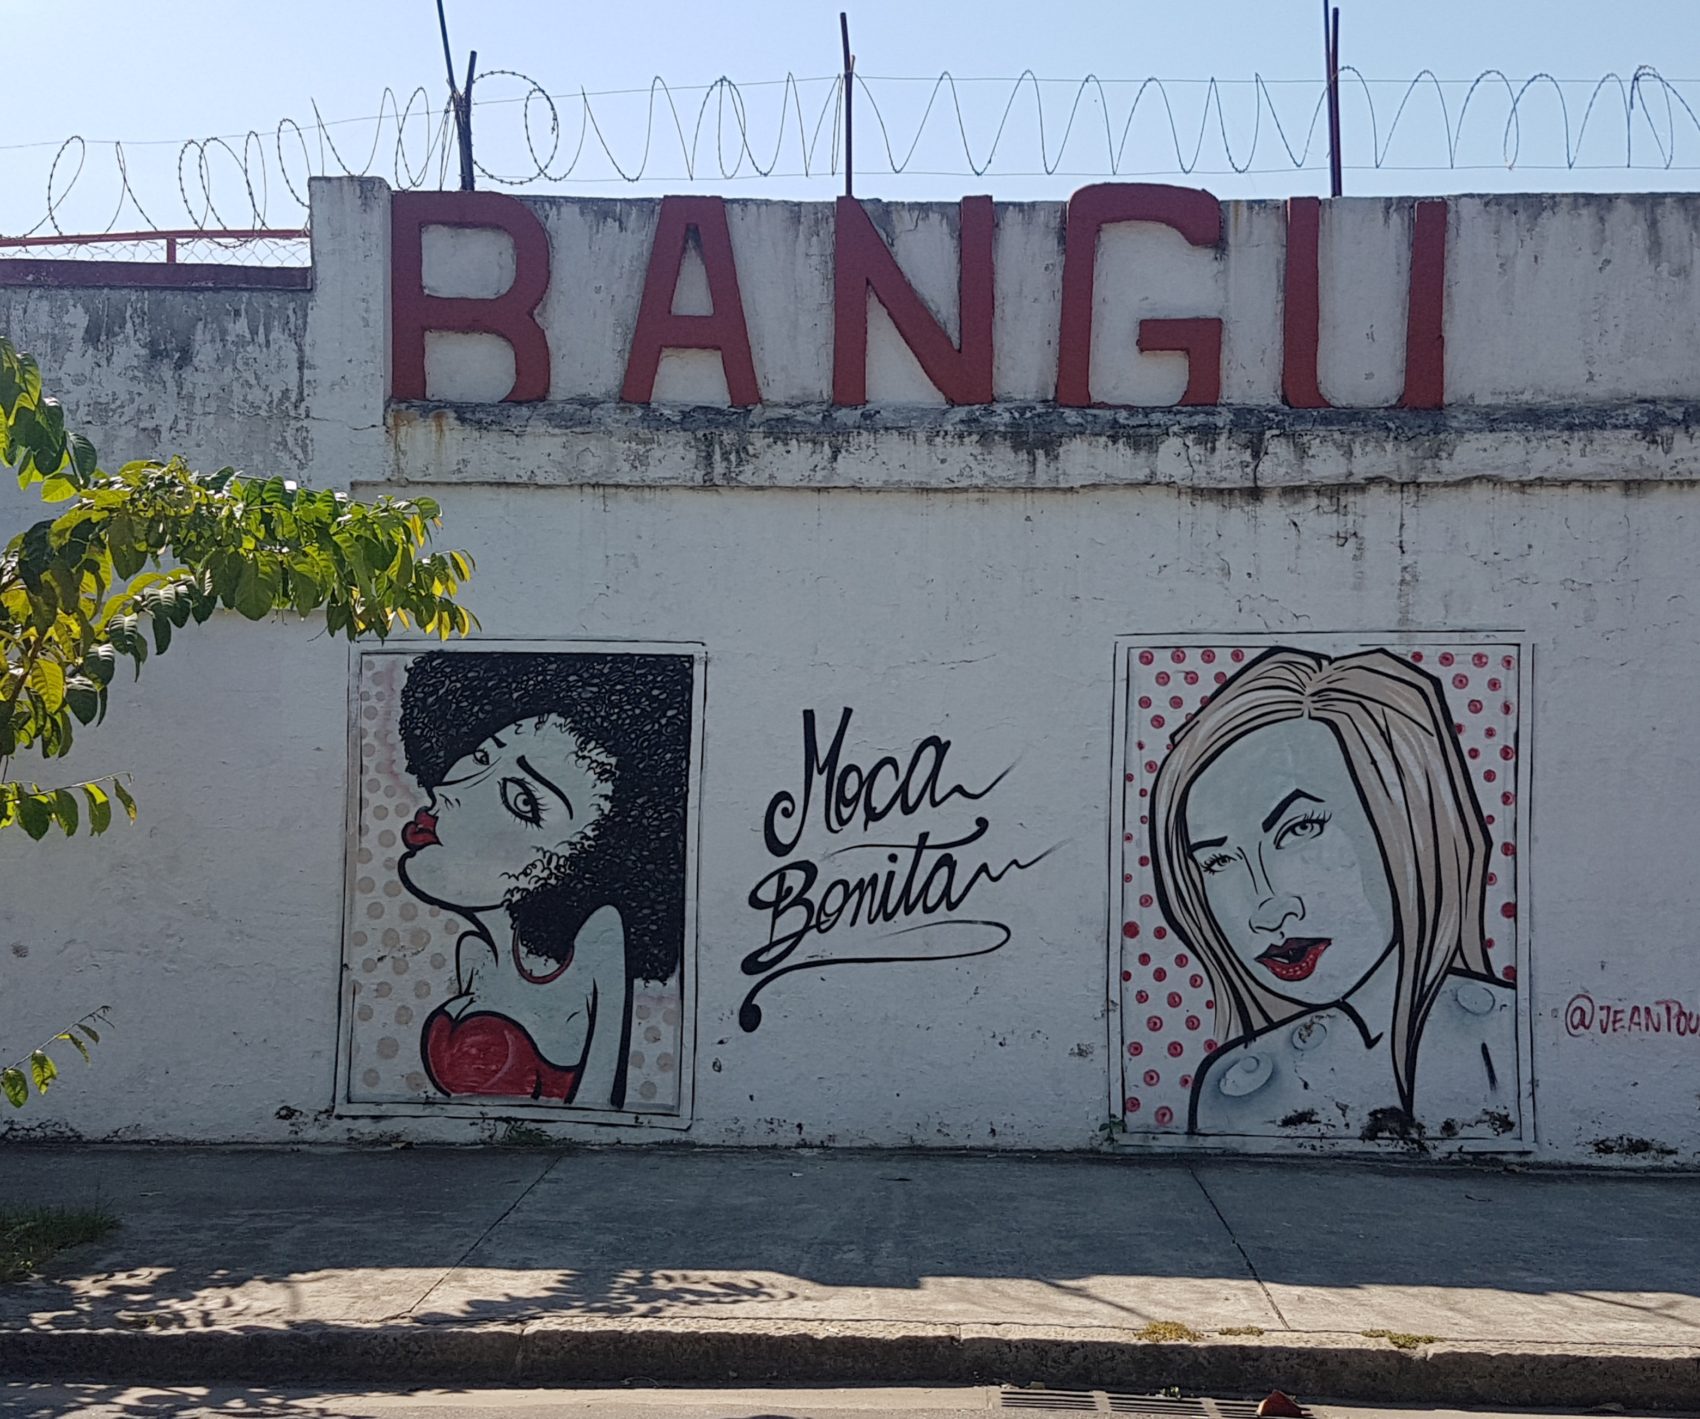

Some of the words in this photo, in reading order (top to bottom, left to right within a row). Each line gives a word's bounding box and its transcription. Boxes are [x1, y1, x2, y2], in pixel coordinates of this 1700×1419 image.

[391, 182, 1445, 408] BANGU
[741, 831, 1058, 976] Bonita
[1565, 993, 1700, 1037] @JEANPOU
